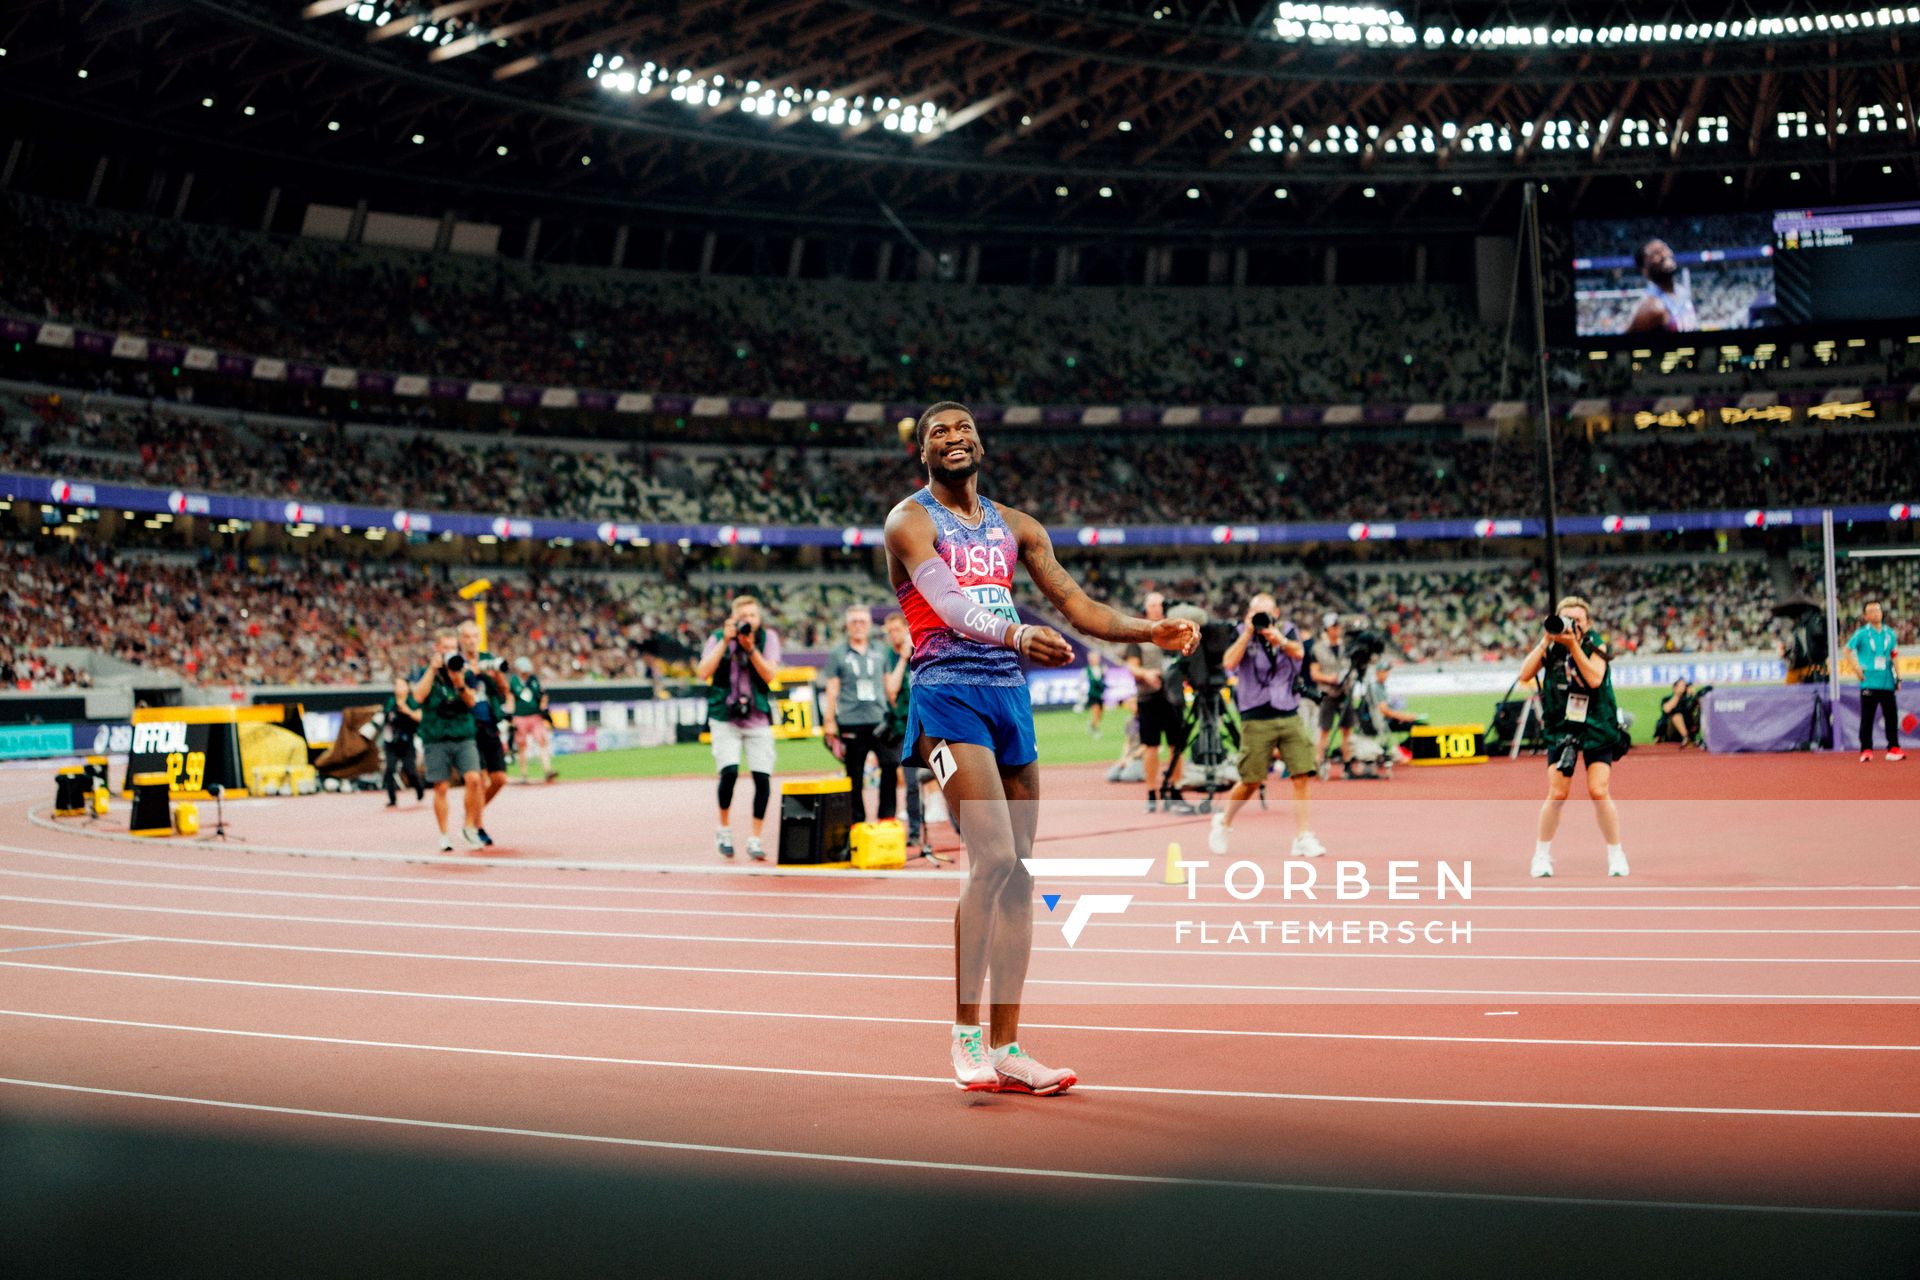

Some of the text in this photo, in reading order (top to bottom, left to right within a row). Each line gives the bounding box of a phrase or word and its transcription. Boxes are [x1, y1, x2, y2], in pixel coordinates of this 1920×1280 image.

[950, 544, 1009, 577] USA
[970, 586, 1010, 604] TDK
[964, 607, 1000, 637] USA
[933, 750, 946, 779] 7
